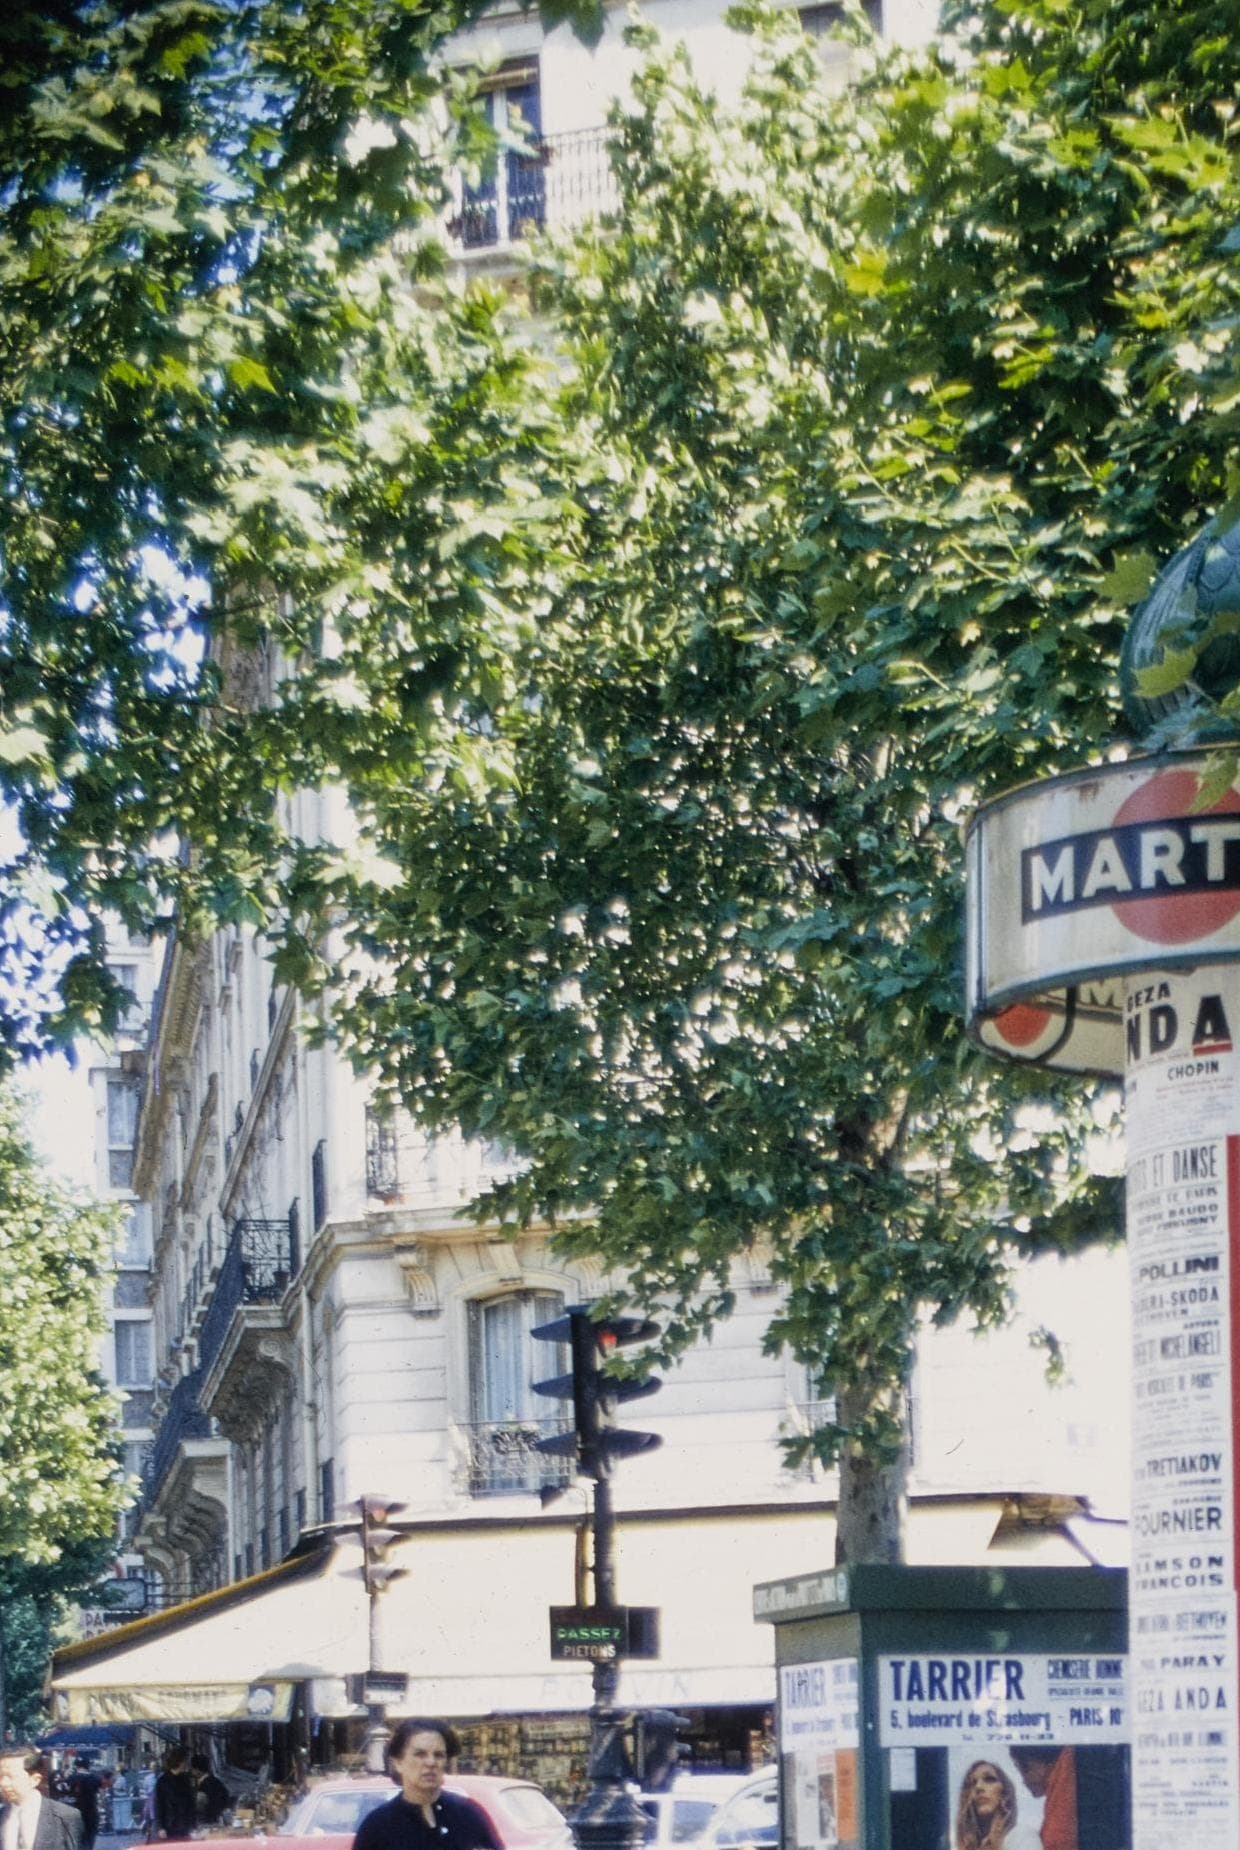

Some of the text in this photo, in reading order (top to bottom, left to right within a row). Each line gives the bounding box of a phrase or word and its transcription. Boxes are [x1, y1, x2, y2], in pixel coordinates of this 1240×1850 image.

[1167, 1060, 1219, 1081] CHOPIN
[1173, 1144, 1218, 1183] DANSE
[1140, 1255, 1219, 1280] POLLINI
[1147, 1453, 1222, 1477] TRETIAKOV
[557, 1627, 621, 1640] PASSEZ
[1161, 1655, 1226, 1669] PARAY
[889, 1659, 1025, 1701] TARRIER
[1175, 1686, 1227, 1711] ANDA
[908, 1709, 963, 1729] boulevard
[968, 1710, 981, 1728] de
[986, 1710, 1052, 1731] Stasbourg
[1069, 1706, 1104, 1727] PARIS
